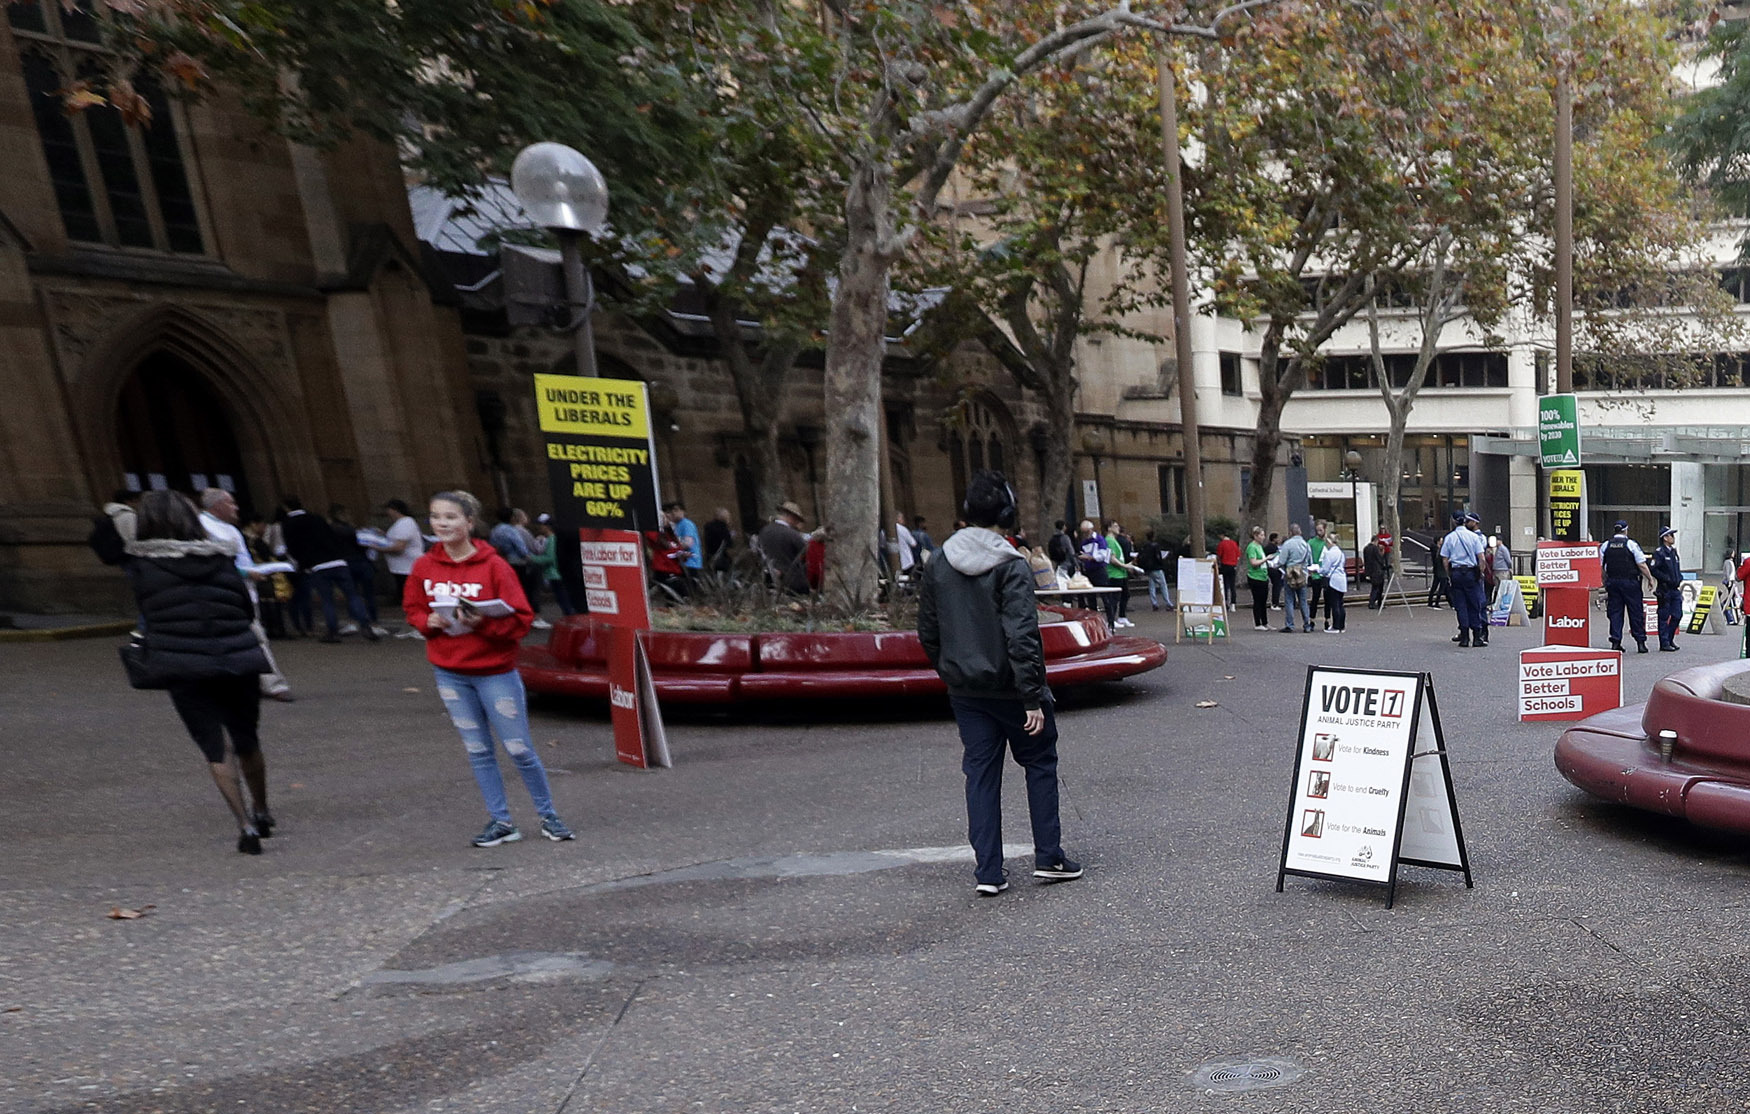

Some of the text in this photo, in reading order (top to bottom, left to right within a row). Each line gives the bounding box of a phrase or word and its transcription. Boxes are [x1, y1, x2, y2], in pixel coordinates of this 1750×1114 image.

[545, 388, 636, 409] UNDER THE
[554, 407, 632, 426] LIBERALS
[1540, 409, 1560, 421] 100%
[546, 443, 648, 465] ELECTRICITY
[569, 463, 632, 482] PRICES
[573, 481, 633, 500] ARE UP
[586, 500, 624, 518] 60%
[1539, 548, 1597, 559] Vote Labor for
[1539, 561, 1568, 570] Better
[1540, 571, 1574, 581] Schools
[424, 579, 483, 598] Labor
[1548, 615, 1586, 628] Labor
[1523, 661, 1615, 678] Vote Labor for
[1524, 682, 1566, 694] Better
[1322, 685, 1379, 716] VOTE
[1524, 697, 1575, 711] Schools
[1317, 716, 1401, 729] ANIMAL JUSTICE PARTY
[1338, 744, 1390, 756] Vote for Kindness
[1333, 782, 1390, 798] Vote to end Cruelty
[1327, 821, 1386, 836] Vote for the Animals
